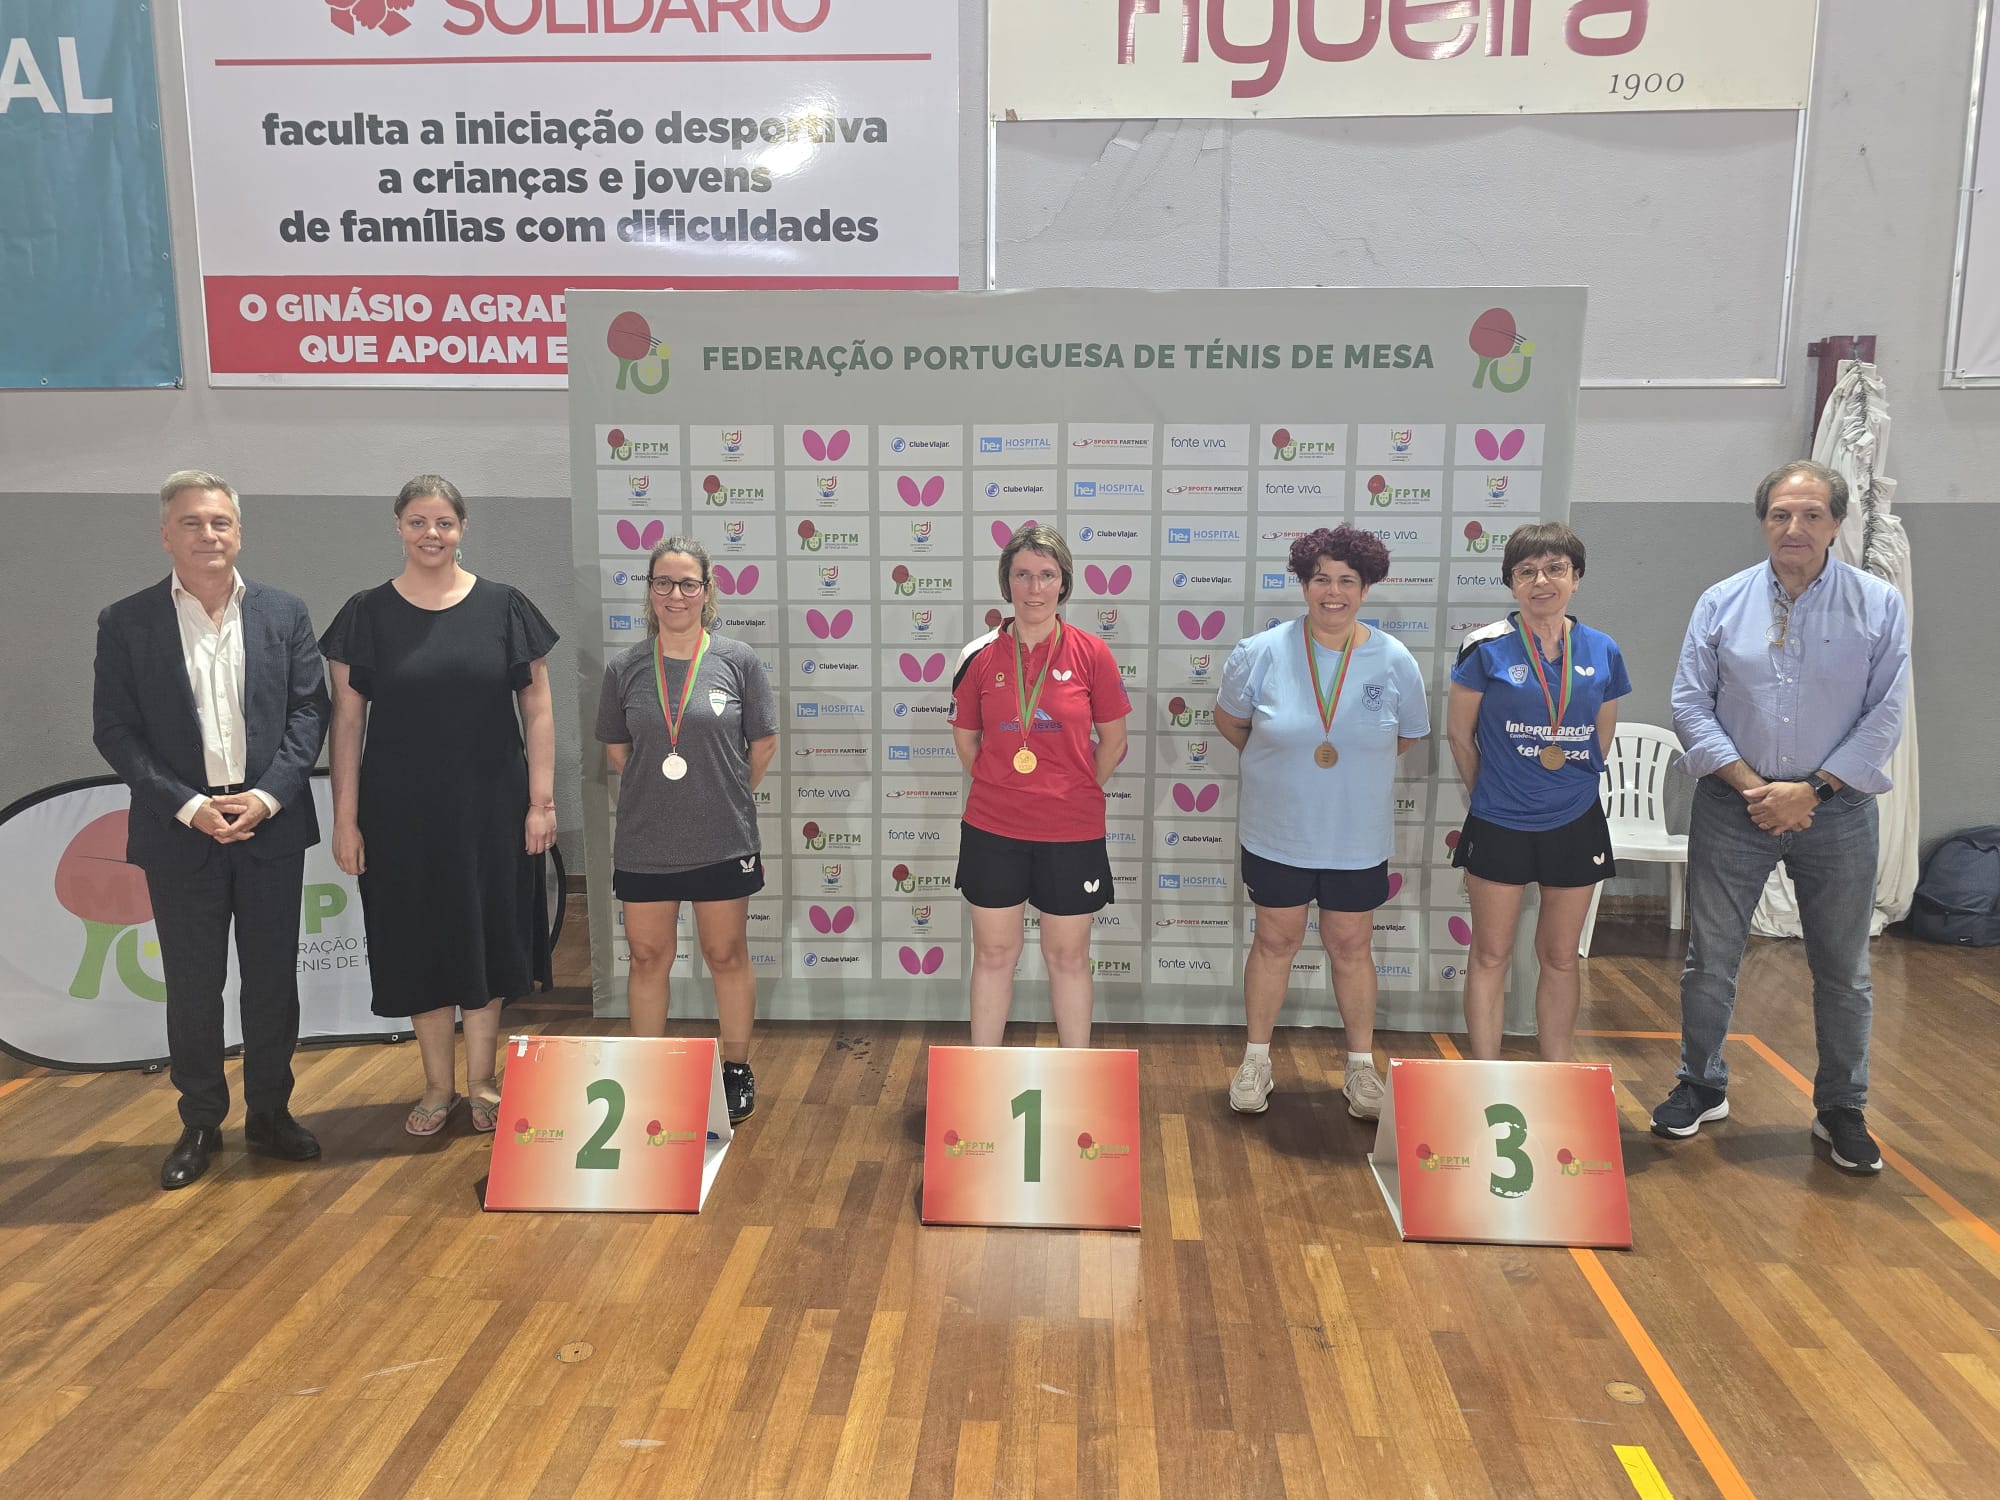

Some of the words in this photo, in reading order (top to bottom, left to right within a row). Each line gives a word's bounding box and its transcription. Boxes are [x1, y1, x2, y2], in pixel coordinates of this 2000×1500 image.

[0, 36, 112, 114] AL
[1608, 72, 1685, 99] 1900
[263, 113, 408, 146] faculta
[420, 121, 445, 145] a
[456, 110, 643, 149] iniciação
[655, 111, 888, 151] desportiva
[379, 169, 402, 193] a
[413, 161, 588, 199] crianças
[599, 168, 623, 192] e
[633, 160, 773, 200] jovens
[279, 210, 329, 243] de
[341, 208, 504, 242] famílias
[516, 217, 605, 242] com
[617, 209, 879, 242] dificuldades
[239, 293, 267, 322] O
[276, 286, 433, 322] GINÁSIO
[299, 335, 378, 363] QUE
[387, 335, 537, 363] APOIAM
[547, 335, 568, 363] E
[703, 340, 893, 377] FEDERAÇÃO
[903, 343, 1124, 371] PORTUGUESA
[1133, 344, 1176, 369] DE
[1184, 338, 1281, 369] TÉNIS
[1291, 344, 1334, 368] DE
[1343, 344, 1434, 369] MESA
[1005, 438, 1050, 447] HOSPITAL
[1171, 437, 1199, 448] fonte
[1203, 438, 1226, 448] viva
[634, 443, 669, 452] FPTM
[1299, 443, 1335, 452] FPTM
[1099, 483, 1144, 493] HOSPITAL
[1266, 484, 1294, 494] fonte
[1298, 485, 1321, 494] viva
[730, 488, 764, 498] FPTM
[1395, 488, 1431, 498] FPTM
[824, 534, 859, 543] FPTM
[1194, 531, 1240, 539] HOSPITAL
[1395, 531, 1418, 540] viva
[1492, 534, 1511, 544] FP
[919, 579, 952, 588] FPTM
[1457, 575, 1486, 586] fonte
[1490, 576, 1504, 586] viv
[1383, 621, 1429, 630] HOSPITAL
[1119, 666, 1136, 675] TM
[821, 704, 865, 713] HOSPITAL
[913, 748, 956, 756] HOSPITAL
[752, 792, 771, 801] TM
[798, 788, 825, 798] fonte
[828, 789, 850, 798] viva
[1397, 800, 1415, 809] TM
[829, 834, 861, 843] FPTM
[889, 829, 915, 840] fonte
[918, 830, 940, 840] viva
[1106, 833, 1136, 841] SPITAL
[918, 877, 950, 885] FPTM
[1184, 877, 1227, 885] HOSPITAL
[1024, 918, 1040, 927] TM
[1098, 917, 1120, 926] viva
[337, 955, 360, 968] DE
[751, 955, 776, 963] PITAL
[1159, 958, 1186, 969] fonte
[1189, 959, 1211, 969] viva
[1098, 962, 1131, 971] FPTM
[1375, 966, 1413, 975] OSPITAL
[575, 1078, 625, 1169] 2
[1011, 1089, 1041, 1182] 1
[1484, 1103, 1534, 1199] 3
